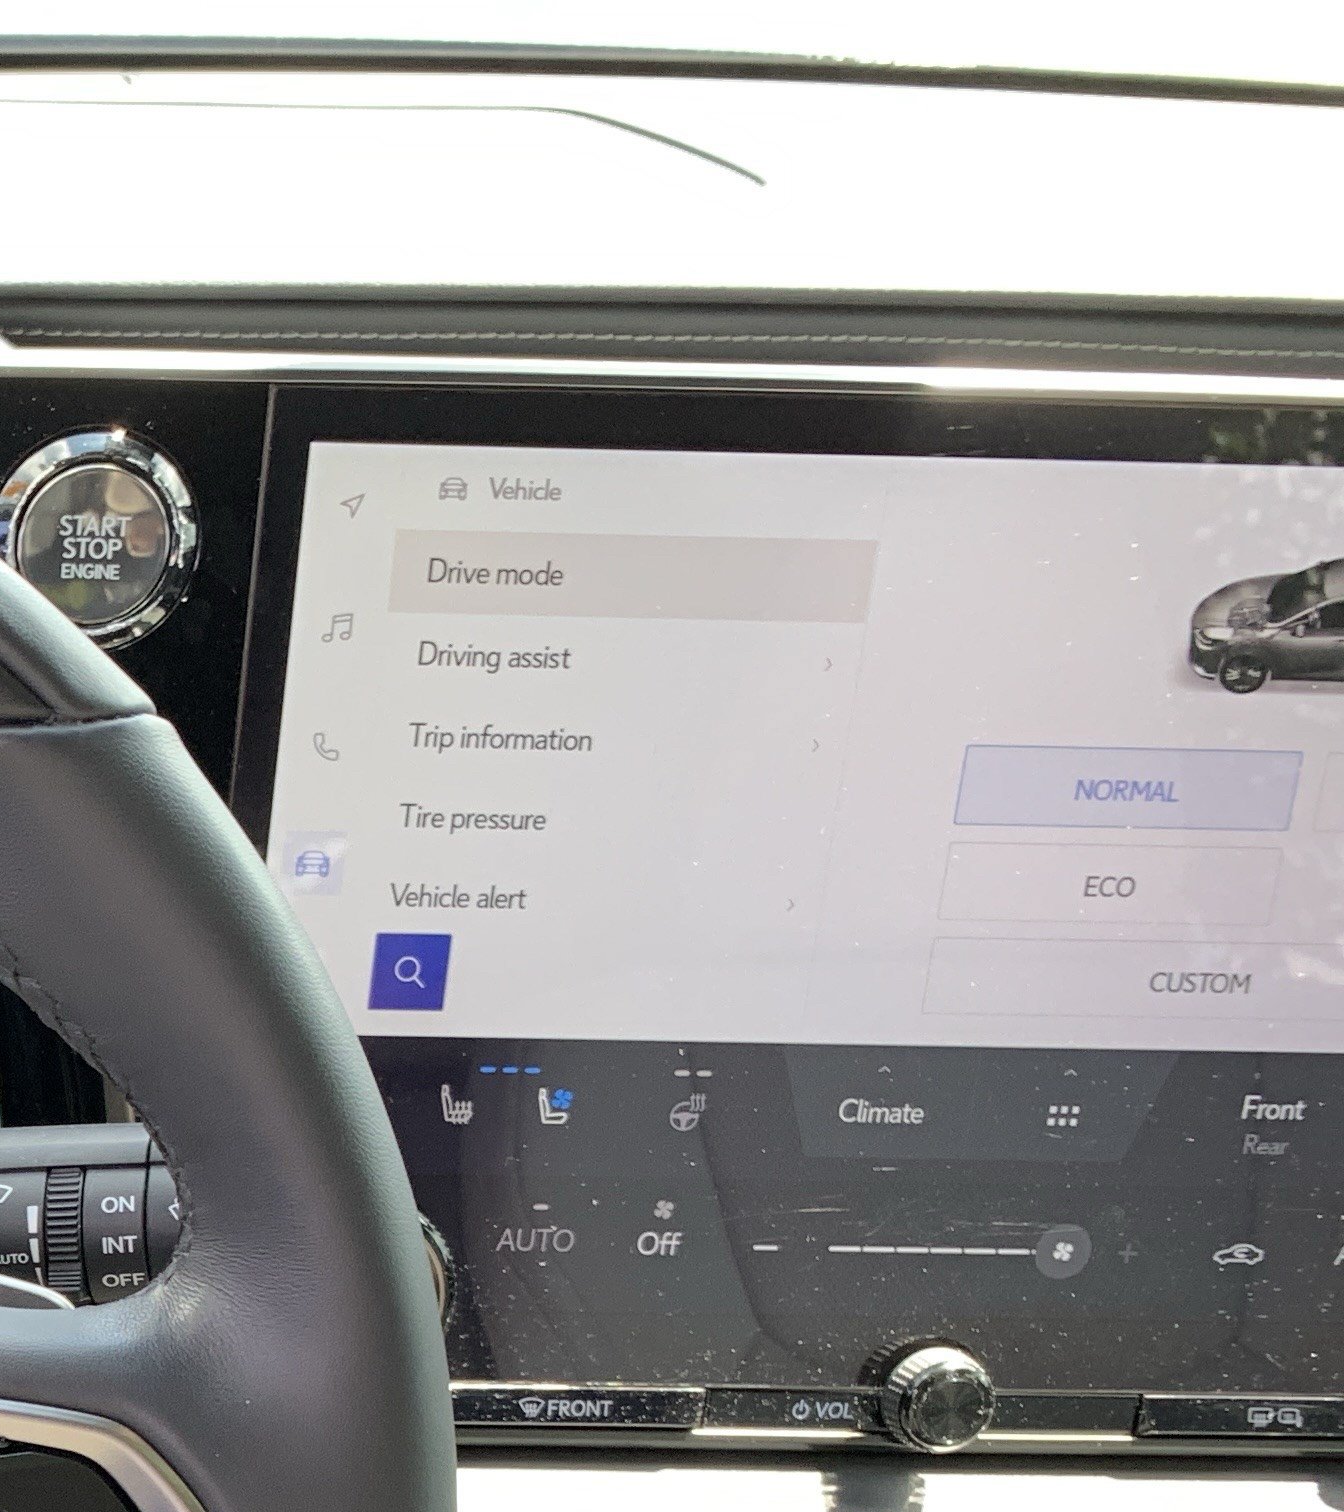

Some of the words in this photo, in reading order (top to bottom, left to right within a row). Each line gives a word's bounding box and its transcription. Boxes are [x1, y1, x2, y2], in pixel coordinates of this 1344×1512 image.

[489, 477, 562, 501] Vehicle
[58, 515, 132, 537] START
[62, 538, 123, 560] STOP
[60, 563, 120, 581] ENGINE
[426, 557, 490, 585] Drive
[496, 561, 564, 587] mode
[417, 641, 501, 674] Driving
[507, 647, 572, 670] assist
[410, 722, 454, 754] Trip
[460, 725, 593, 753] information
[1073, 779, 1180, 803] NORMAL
[400, 803, 445, 830] Tire
[450, 809, 547, 834] pressure
[390, 884, 470, 909] Vehicle
[476, 885, 527, 910] alert
[1083, 876, 1136, 898] ECO
[1149, 972, 1252, 995] CUSTOM
[838, 1098, 925, 1124] Climate
[1241, 1095, 1307, 1122] Front
[1242, 1134, 1290, 1157] Rear
[101, 1195, 135, 1214] ON
[102, 1235, 138, 1255] INT
[496, 1228, 575, 1253] AUTO
[636, 1231, 683, 1256] Off
[102, 1271, 145, 1288] OFF
[547, 1399, 612, 1419] FRONT
[816, 1403, 854, 1420] VOL
